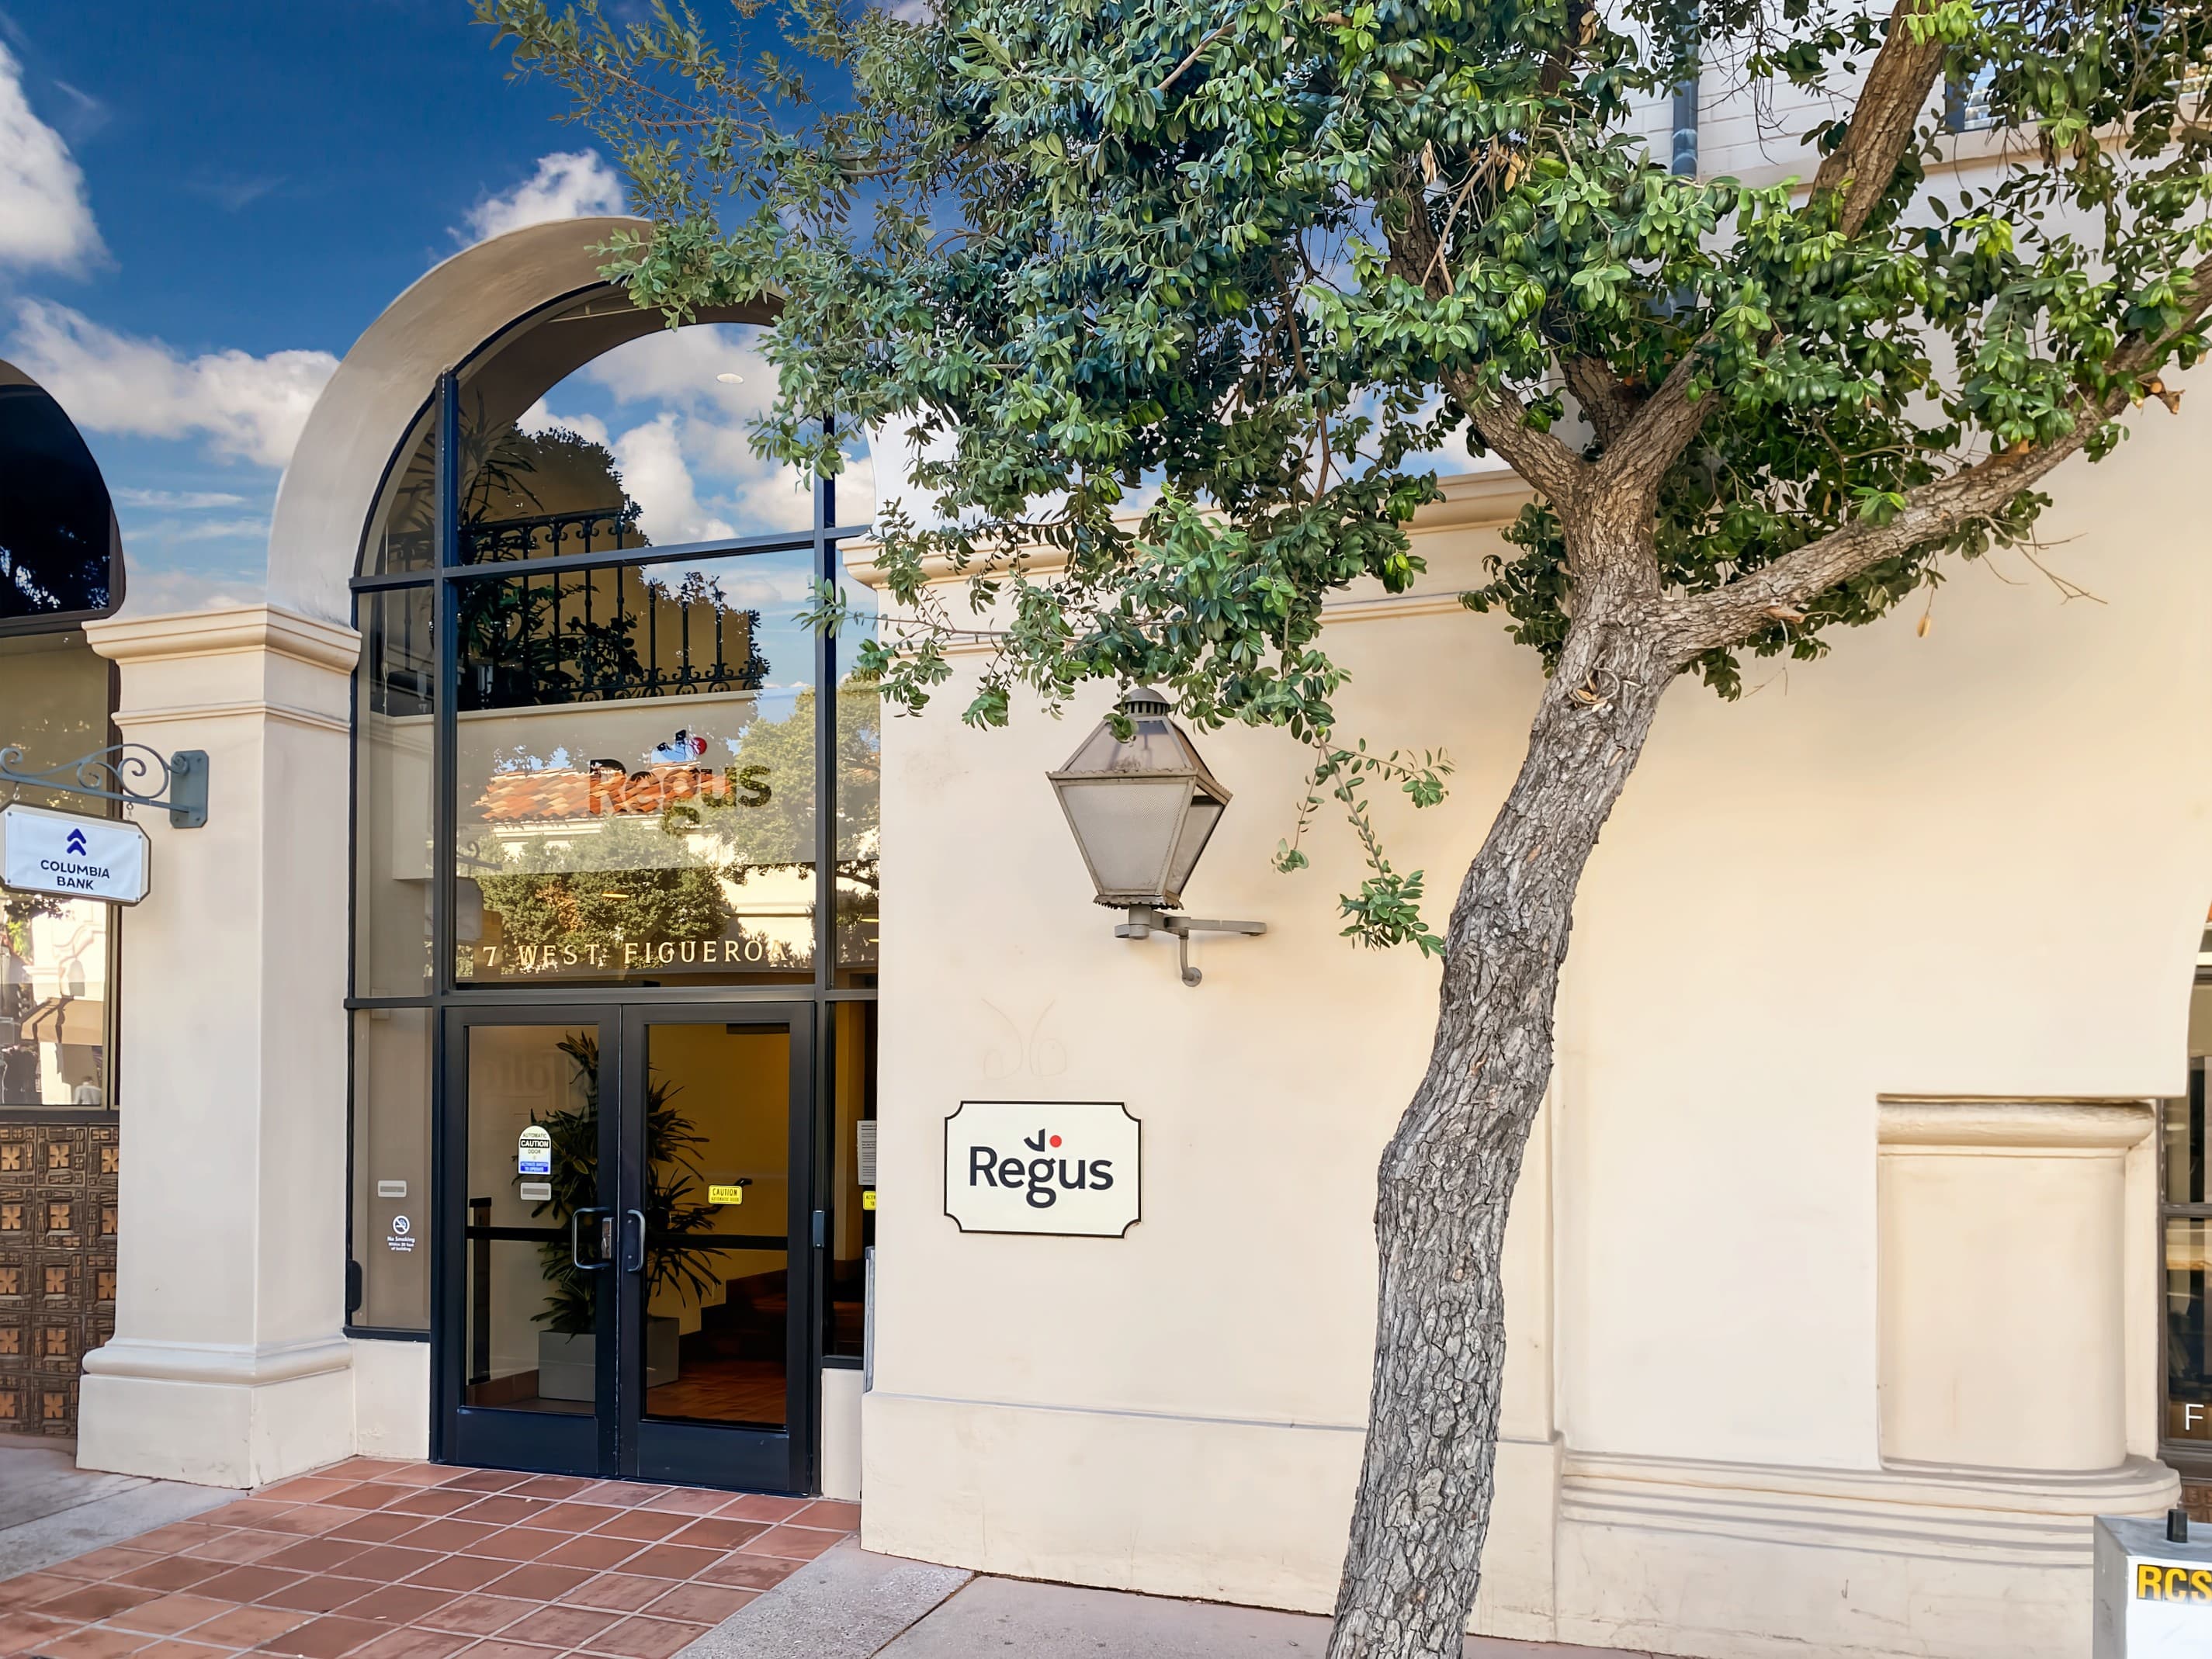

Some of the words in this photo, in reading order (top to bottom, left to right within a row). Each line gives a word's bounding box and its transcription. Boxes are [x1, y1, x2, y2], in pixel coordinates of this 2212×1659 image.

[589, 758, 772, 833] Regus
[40, 859, 110, 879] COLUMBIA
[57, 875, 94, 891] BANK
[483, 946, 498, 967] 7
[518, 944, 600, 967] WEST
[623, 939, 789, 965] FIGUEROA
[969, 1145, 1115, 1209] Regus
[712, 1188, 738, 1197] CAUTION
[2137, 1564, 2212, 1602] RCS
